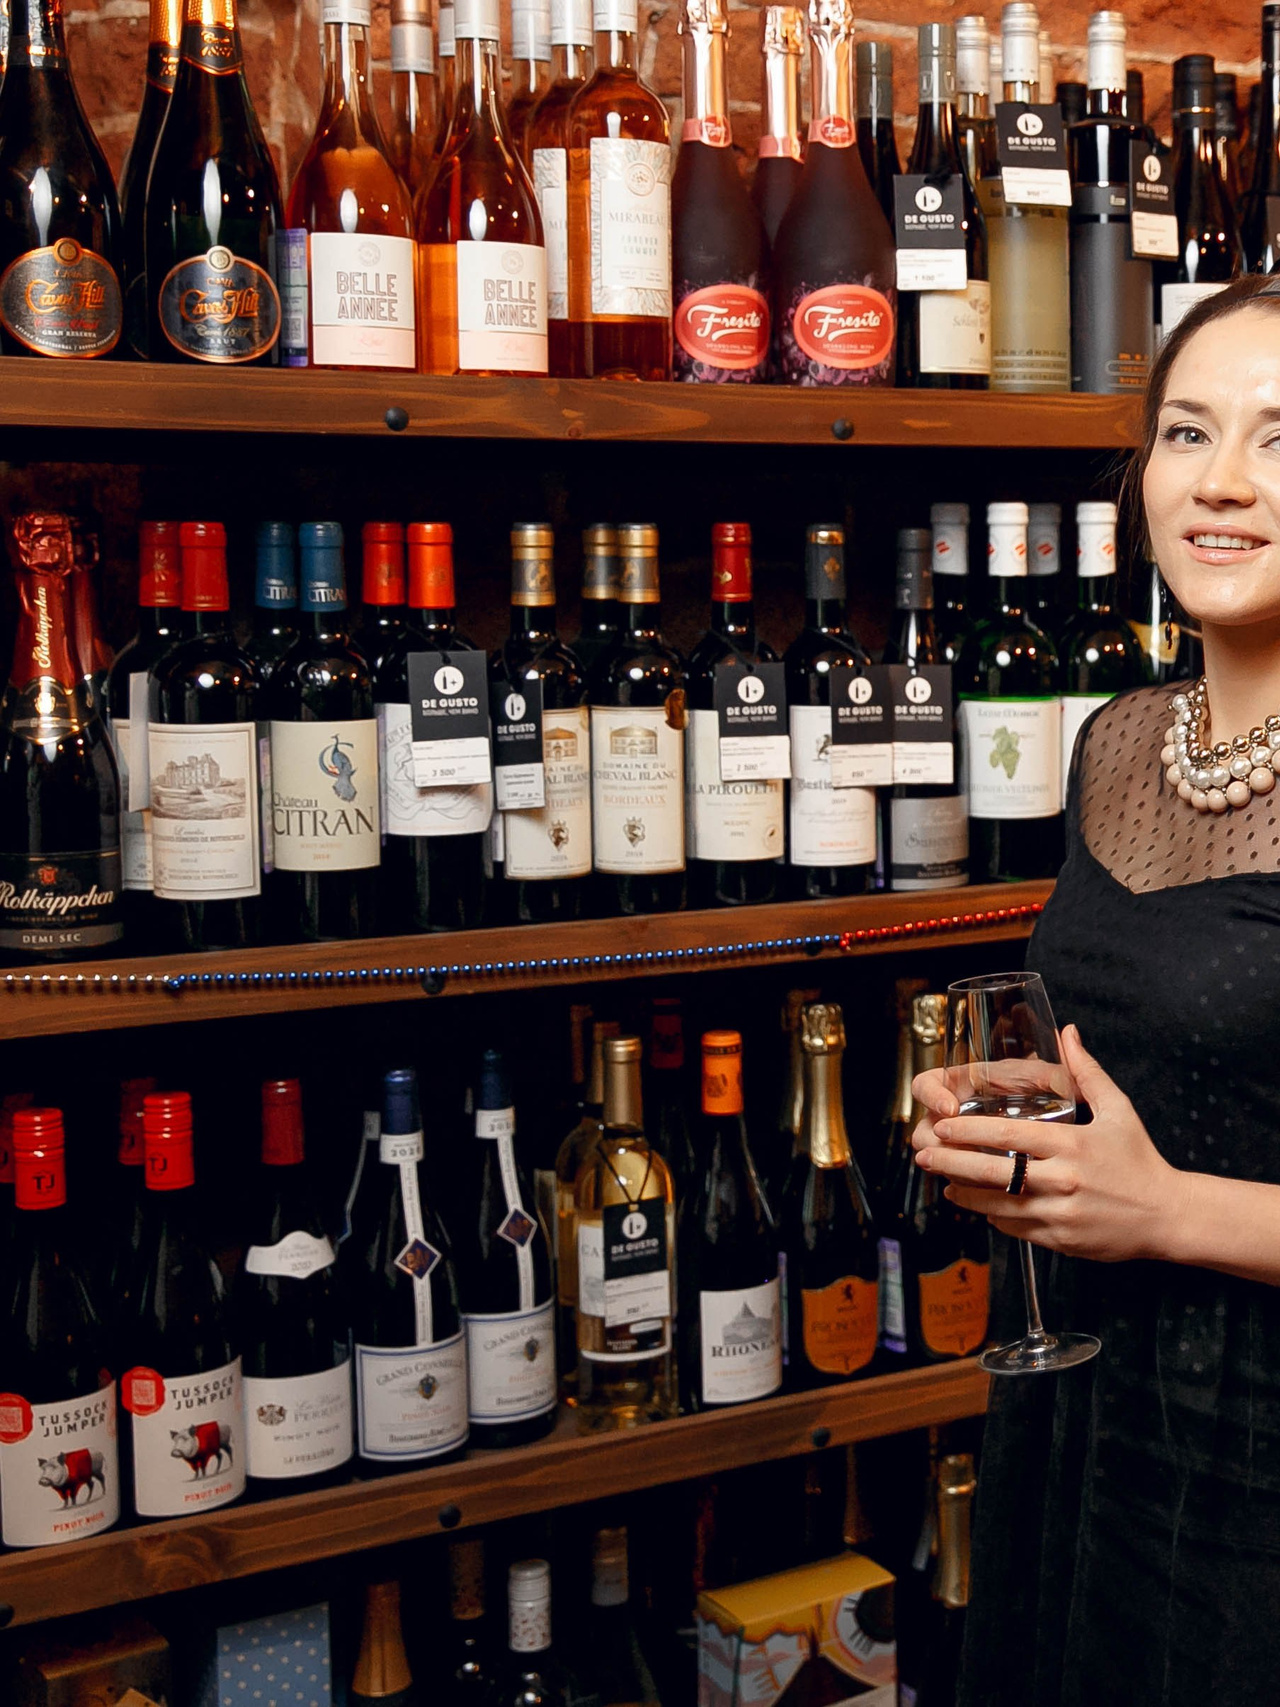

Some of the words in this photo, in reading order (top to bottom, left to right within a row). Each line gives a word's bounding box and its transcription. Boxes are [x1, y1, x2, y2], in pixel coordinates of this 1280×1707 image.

[1007, 137, 1020, 145] DE
[1022, 137, 1056, 146] GUSTO
[904, 214, 918, 224] DE
[919, 214, 955, 223] GUSTO
[336, 271, 398, 297] BELLE
[483, 278, 536, 304] BELLE
[687, 304, 763, 341] Fresita
[804, 305, 882, 341] Fresita
[422, 699, 437, 709] DE
[439, 697, 478, 708] GUSTO
[726, 706, 740, 716] DE
[742, 705, 777, 715] GUSTO
[895, 706, 908, 715] DE
[909, 706, 943, 715] GUSTO
[838, 707, 851, 717] DE
[852, 706, 883, 715] GUSTO
[497, 725, 508, 734] DE
[508, 723, 536, 732] GUSTO
[593, 770, 636, 781] CHEVAL
[639, 770, 677, 781] BLANC
[273, 806, 374, 836] CITRAN
[23, 935, 54, 943] DEMI
[59, 933, 81, 942] SEC
[149, 1157, 168, 1172] TJ
[32, 1174, 56, 1190] TJ
[171, 1375, 235, 1400] TUSSOCK
[175, 1387, 232, 1411] JUMPER
[39, 1401, 108, 1427] TUSSOCK
[43, 1413, 106, 1438] JUMPER
[53, 1518, 82, 1532] PINOT
